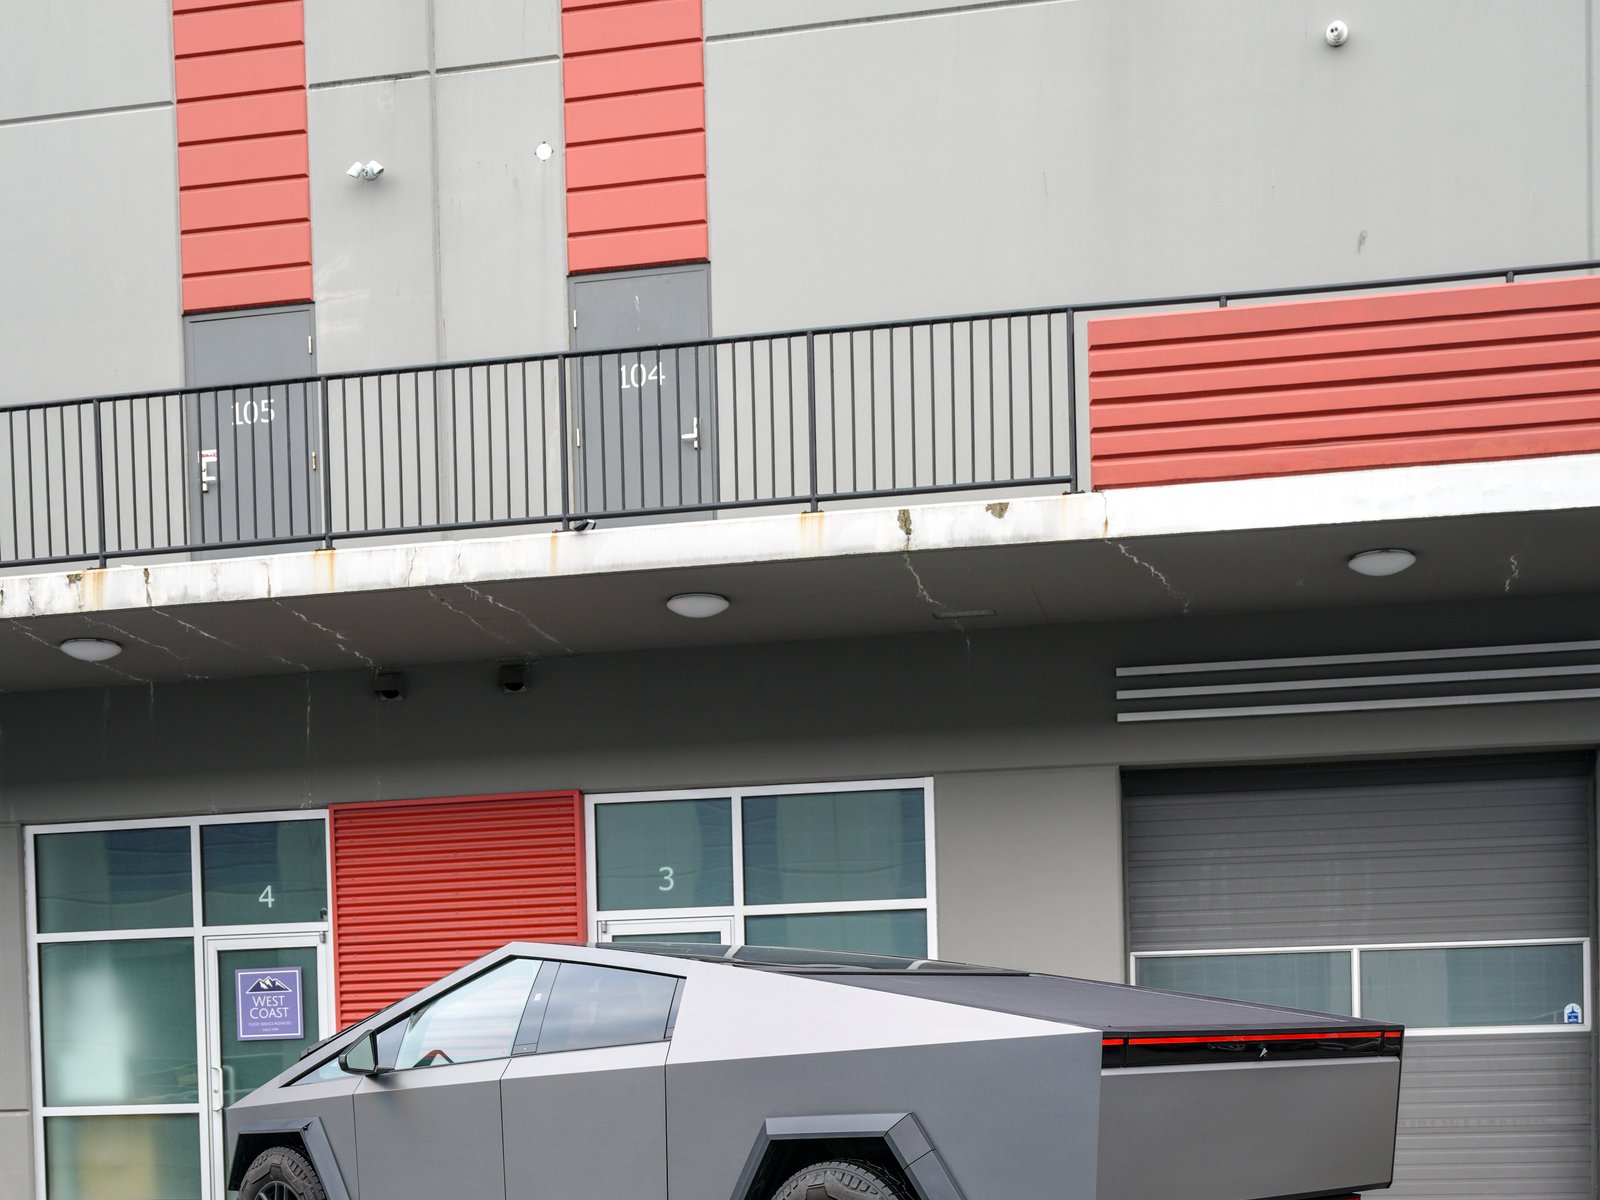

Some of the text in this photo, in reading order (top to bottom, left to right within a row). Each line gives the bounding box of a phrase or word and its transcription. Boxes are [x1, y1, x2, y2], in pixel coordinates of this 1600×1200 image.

[620, 361, 666, 389] 104
[231, 399, 275, 425] 105
[658, 866, 674, 891] 3
[258, 884, 275, 908] 4
[249, 1007, 289, 1019] COAST
[252, 995, 285, 1007] WEST
